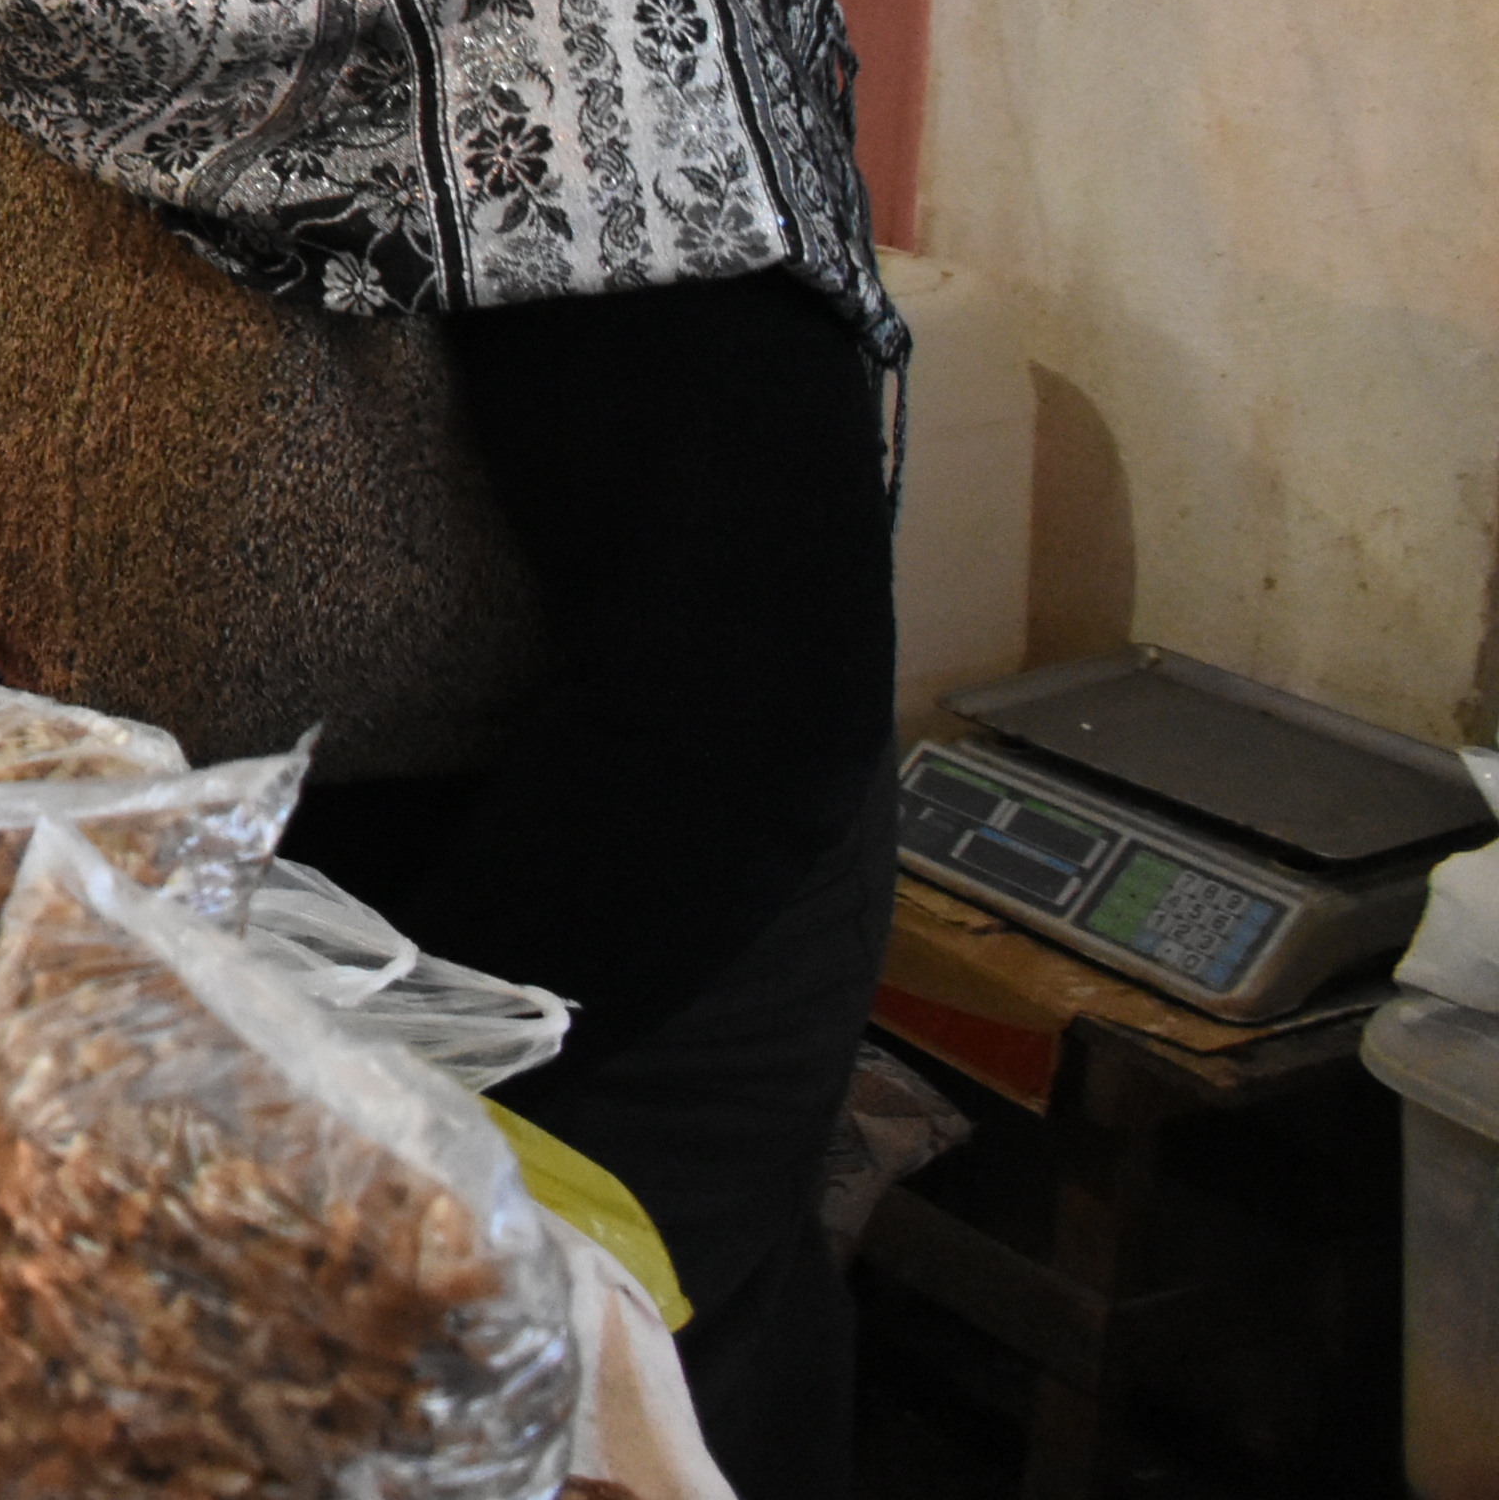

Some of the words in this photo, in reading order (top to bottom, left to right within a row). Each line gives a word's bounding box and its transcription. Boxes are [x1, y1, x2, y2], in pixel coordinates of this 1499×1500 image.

[1183, 873, 1197, 888] 7
[1203, 884, 1218, 899] 8
[1189, 903, 1204, 919] 5
[1212, 914, 1229, 929] 6
[1172, 924, 1191, 939] 2
[1200, 934, 1216, 950] 3
[1183, 954, 1200, 970] 0
